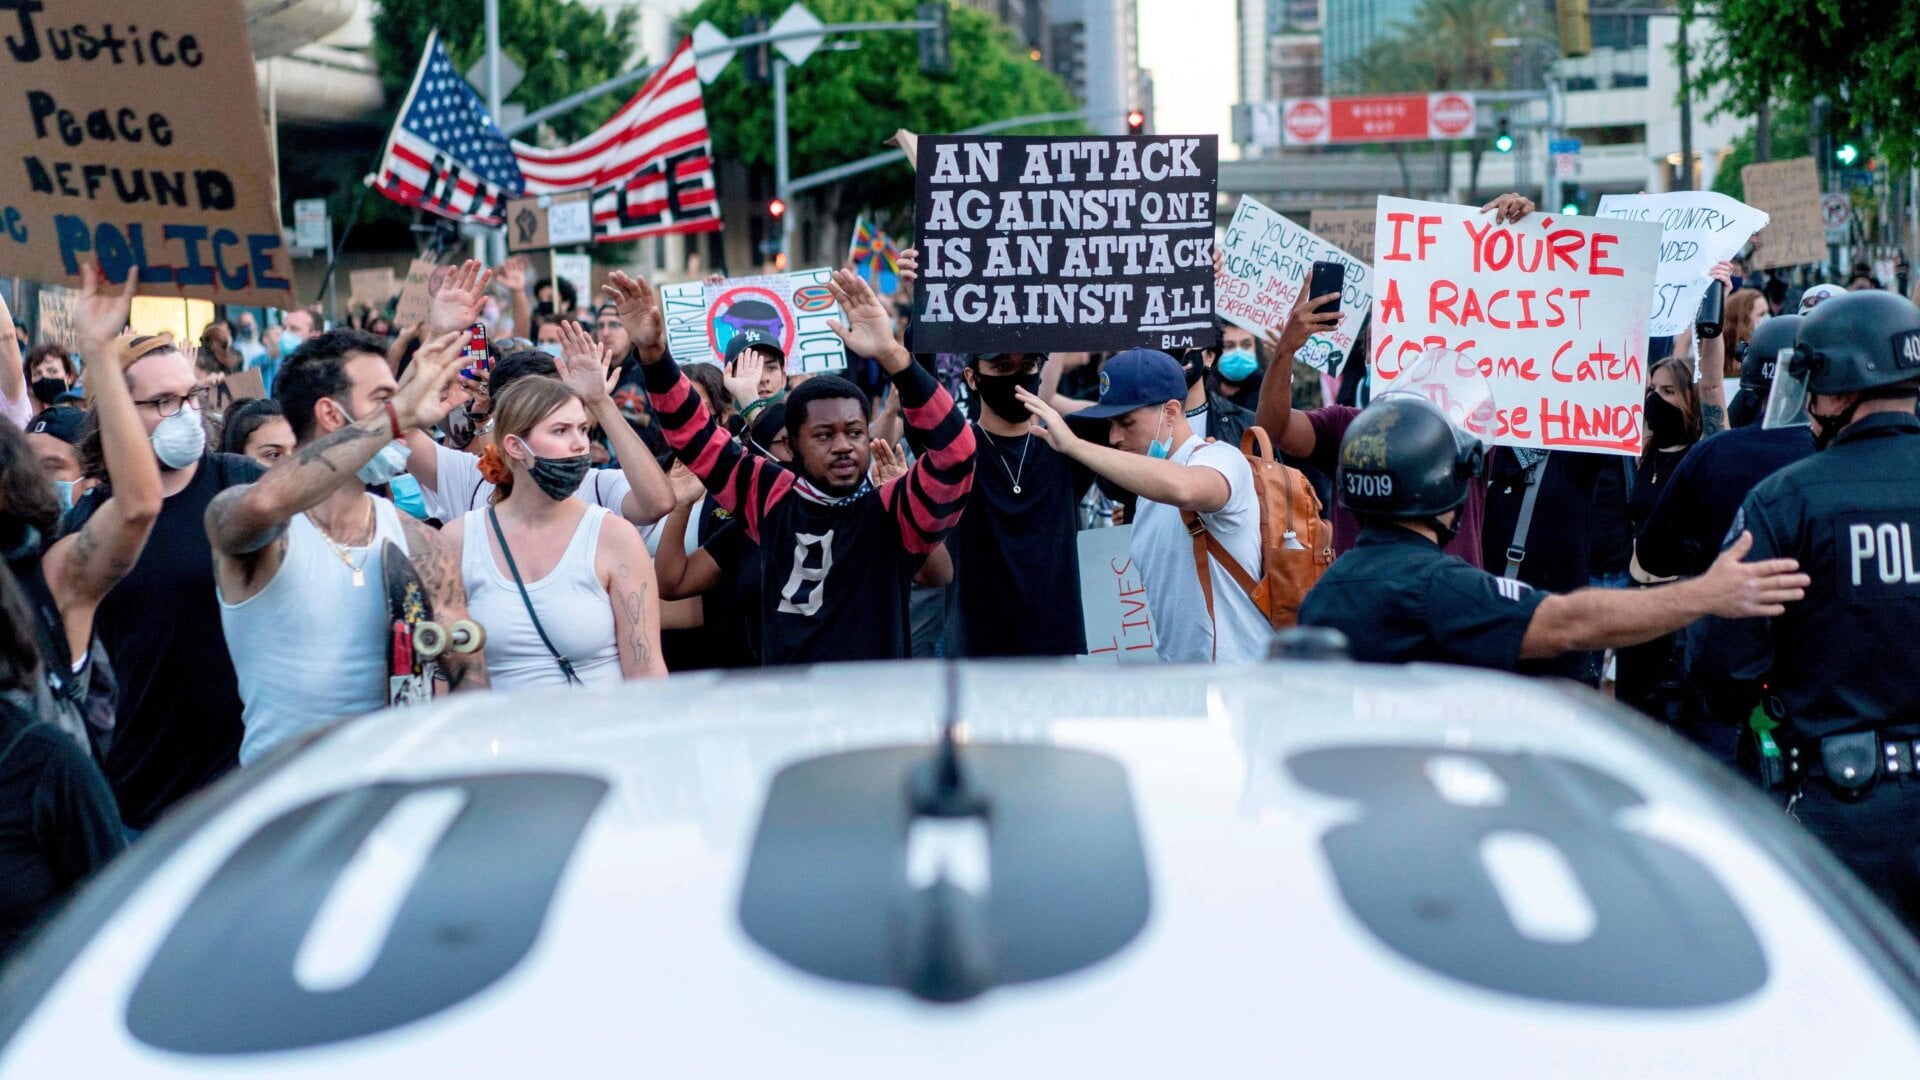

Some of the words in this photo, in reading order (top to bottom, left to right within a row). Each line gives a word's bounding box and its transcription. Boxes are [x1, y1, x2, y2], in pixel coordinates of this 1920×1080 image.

[27, 90, 172, 146] Peace
[24, 156, 235, 210] DEFUND
[930, 142, 1002, 183] AN
[1019, 139, 1201, 183] ATTACK
[925, 188, 1136, 230] AGAINST
[1140, 192, 1210, 222] ONE
[1659, 207, 1736, 233] COUNTRY
[0, 206, 28, 244] e
[54, 213, 290, 291] POLICE
[924, 237, 973, 278] IS
[982, 236, 1052, 276] AN
[1059, 234, 1213, 277] ATTACK
[1225, 228, 1246, 249] OF
[1250, 240, 1311, 282] HEARIN
[1237, 203, 1259, 223] IF
[1260, 217, 1320, 265] YOU'RE
[1383, 213, 1443, 262] IF
[1463, 216, 1625, 277] YOU'RE
[1215, 275, 1250, 298] IRED
[1253, 292, 1287, 315] SOME
[1223, 254, 1264, 288] ACISM,
[1264, 276, 1298, 303] IMAG
[790, 270, 845, 372] POLICE
[920, 283, 1133, 324] AGAINST
[1140, 285, 1211, 325] ALL
[1380, 278, 1406, 325] A
[1429, 279, 1591, 330] RACIST
[744, 329, 761, 342] LA
[1161, 334, 1194, 350] BLM
[1454, 339, 1541, 381] Come
[1552, 337, 1642, 385] Catch
[1762, 362, 1776, 379] 42
[1539, 397, 1643, 446] HANDS
[1346, 473, 1393, 497] 37019
[777, 529, 835, 617] 8
